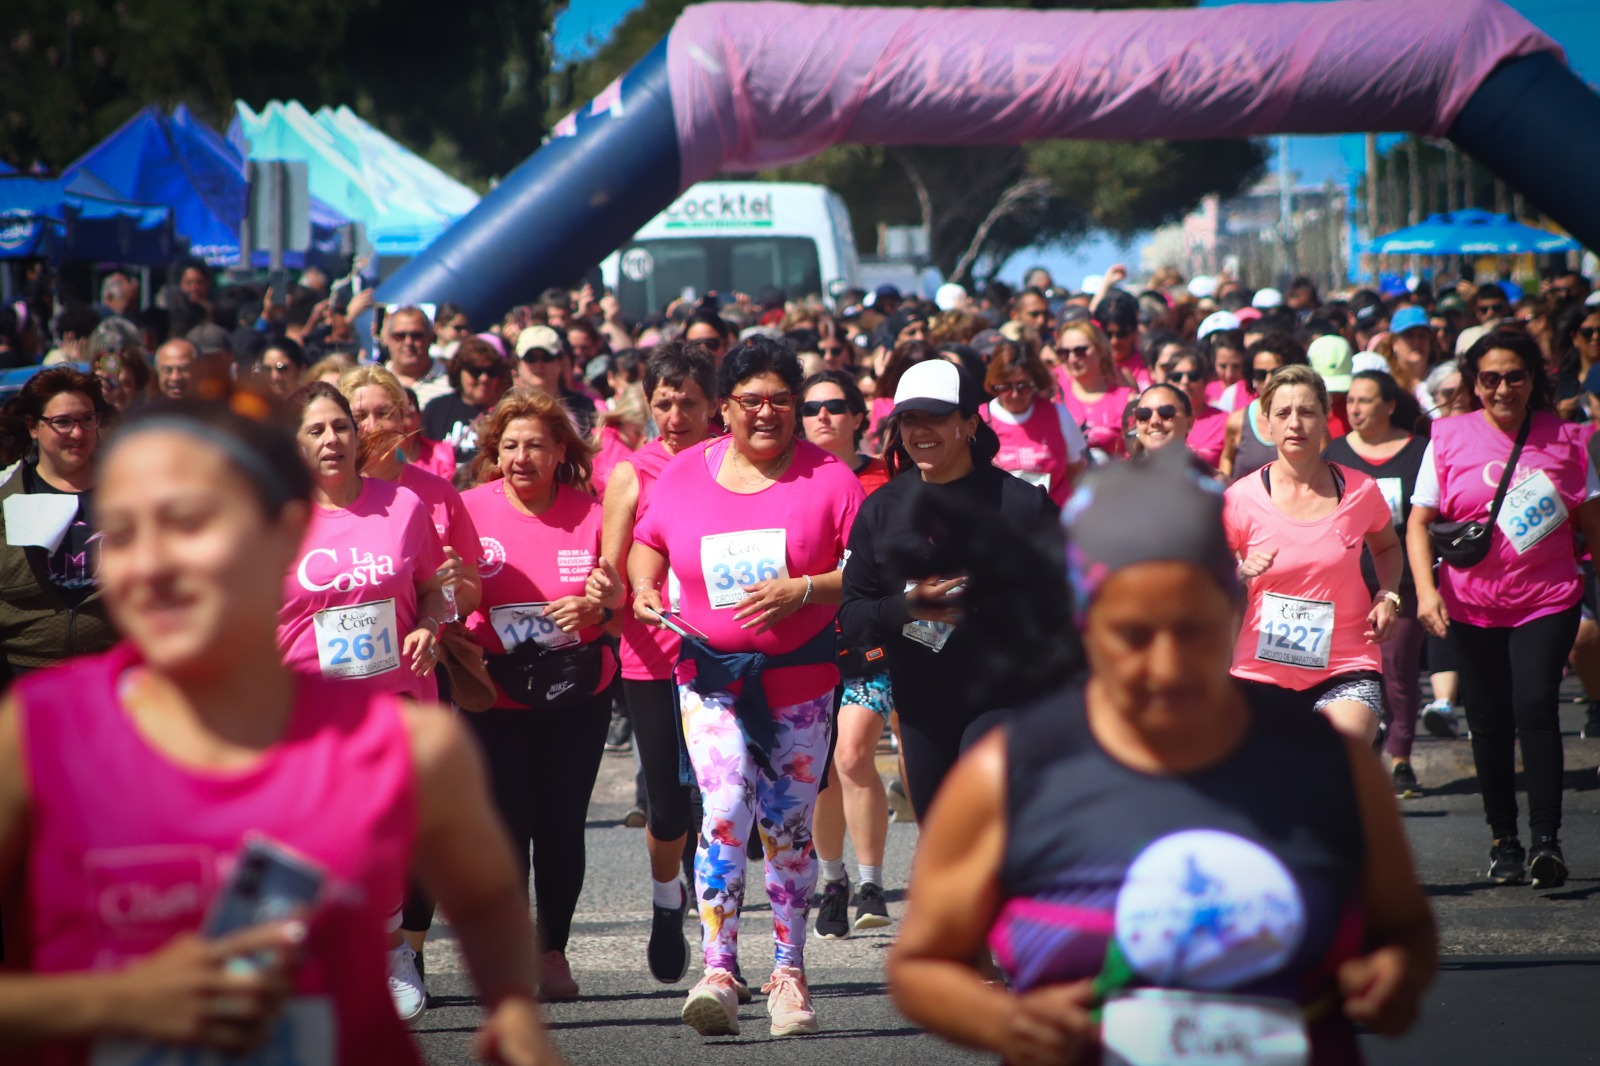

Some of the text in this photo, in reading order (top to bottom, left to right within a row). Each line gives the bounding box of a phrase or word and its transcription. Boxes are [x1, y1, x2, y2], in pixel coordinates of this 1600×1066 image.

[1510, 496, 1557, 537] 389
[297, 548, 396, 593] Costa
[349, 547, 375, 565] La
[713, 558, 779, 590] 336
[328, 627, 393, 667] 261
[1264, 620, 1326, 653] 1227
[1261, 648, 1324, 665] CIRCUITO DE MARATONES
[549, 681, 569, 693] NIKE
